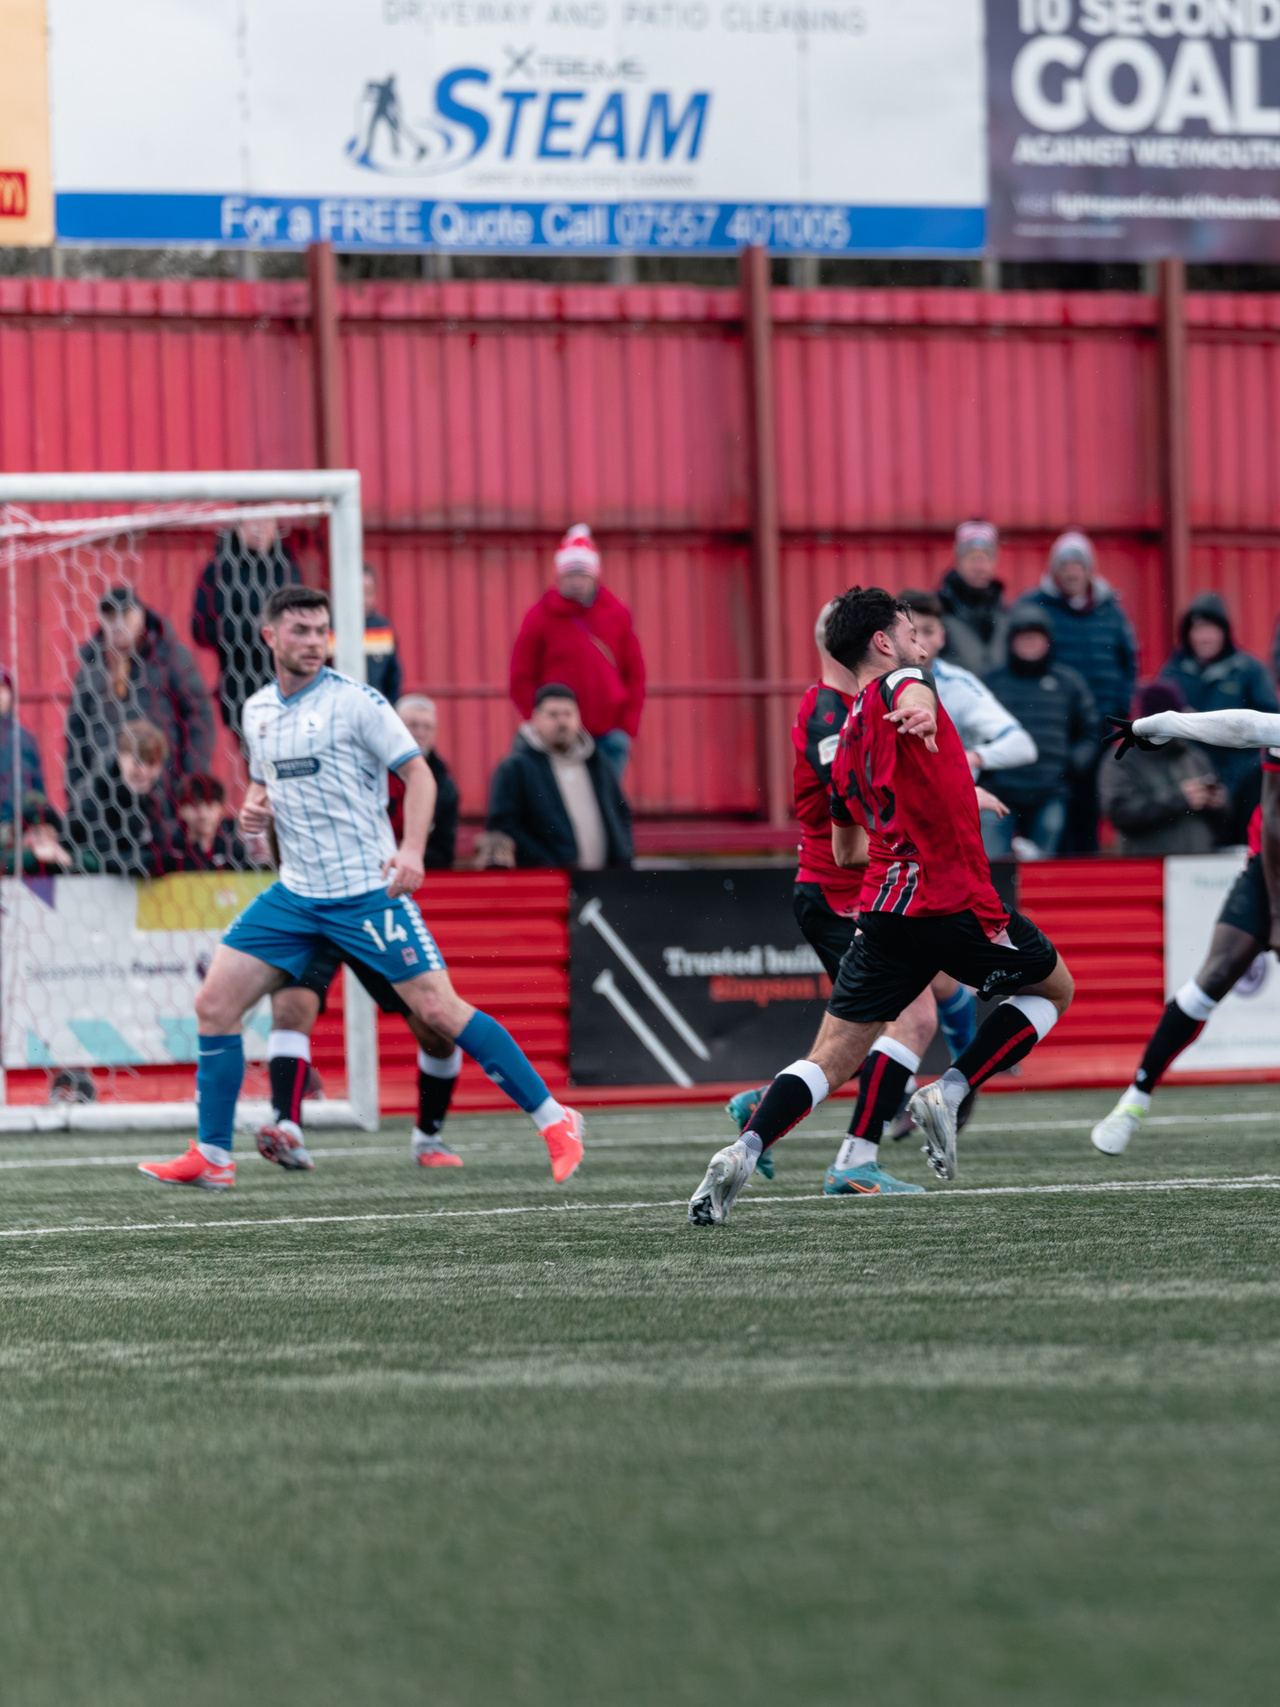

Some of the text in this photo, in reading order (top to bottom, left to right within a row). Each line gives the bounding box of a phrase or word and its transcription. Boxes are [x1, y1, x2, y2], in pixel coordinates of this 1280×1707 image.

[382, 0, 868, 36] DRIVEWAY AND PATIO CLEANING
[1018, 0, 1072, 34] 10
[435, 66, 710, 171] STEAM
[1012, 133, 1130, 167] AGAINST
[221, 197, 281, 241] For
[286, 205, 312, 241] a
[318, 198, 423, 243] FREE
[430, 200, 534, 246] Quote
[541, 202, 609, 246] Call
[361, 908, 409, 952] 14
[662, 946, 763, 976] Trusted
